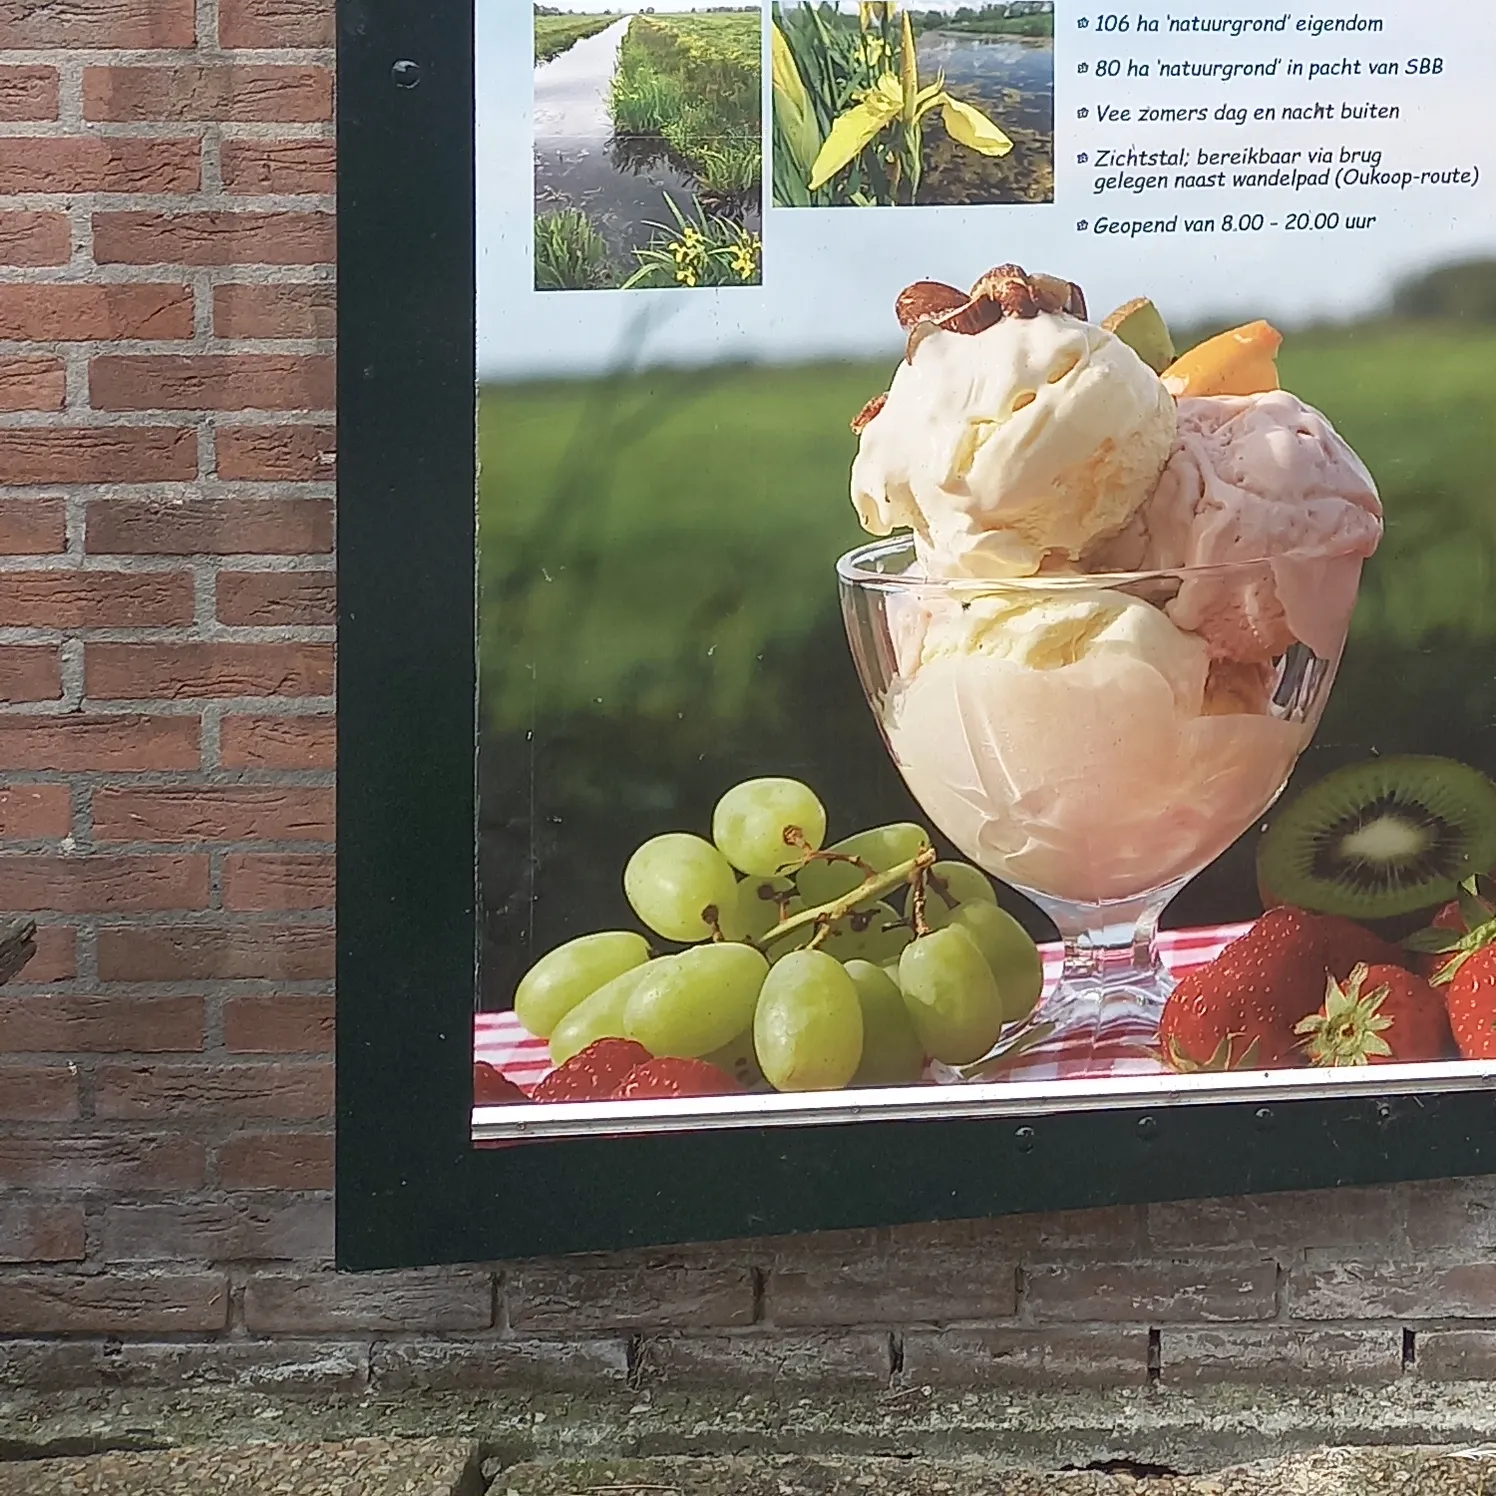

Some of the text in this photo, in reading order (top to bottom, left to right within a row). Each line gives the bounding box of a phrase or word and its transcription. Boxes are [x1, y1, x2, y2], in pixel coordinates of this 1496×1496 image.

[1094, 14, 1130, 33] 106
[1136, 13, 1160, 33] ha
[1295, 13, 1383, 37] eigendom
[1094, 59, 1121, 78] 80
[1126, 58, 1150, 78] ha
[1286, 58, 1304, 76] in
[1307, 57, 1362, 81] pacht
[1368, 62, 1399, 76] van
[1404, 57, 1444, 75] SBB
[1096, 101, 1400, 126] Vee zomers dag en nacht buiten
[1093, 146, 1382, 169] Zichtstal; bereikbaar via brug
[1092, 166, 1480, 195] gelegen naast wandelpad (Oukoop-route)
[1093, 214, 1178, 239] Geopend
[1183, 219, 1215, 233] van
[1221, 213, 1265, 233] 8.00
[1284, 211, 1340, 231] 20.00
[1345, 215, 1377, 230] uur
